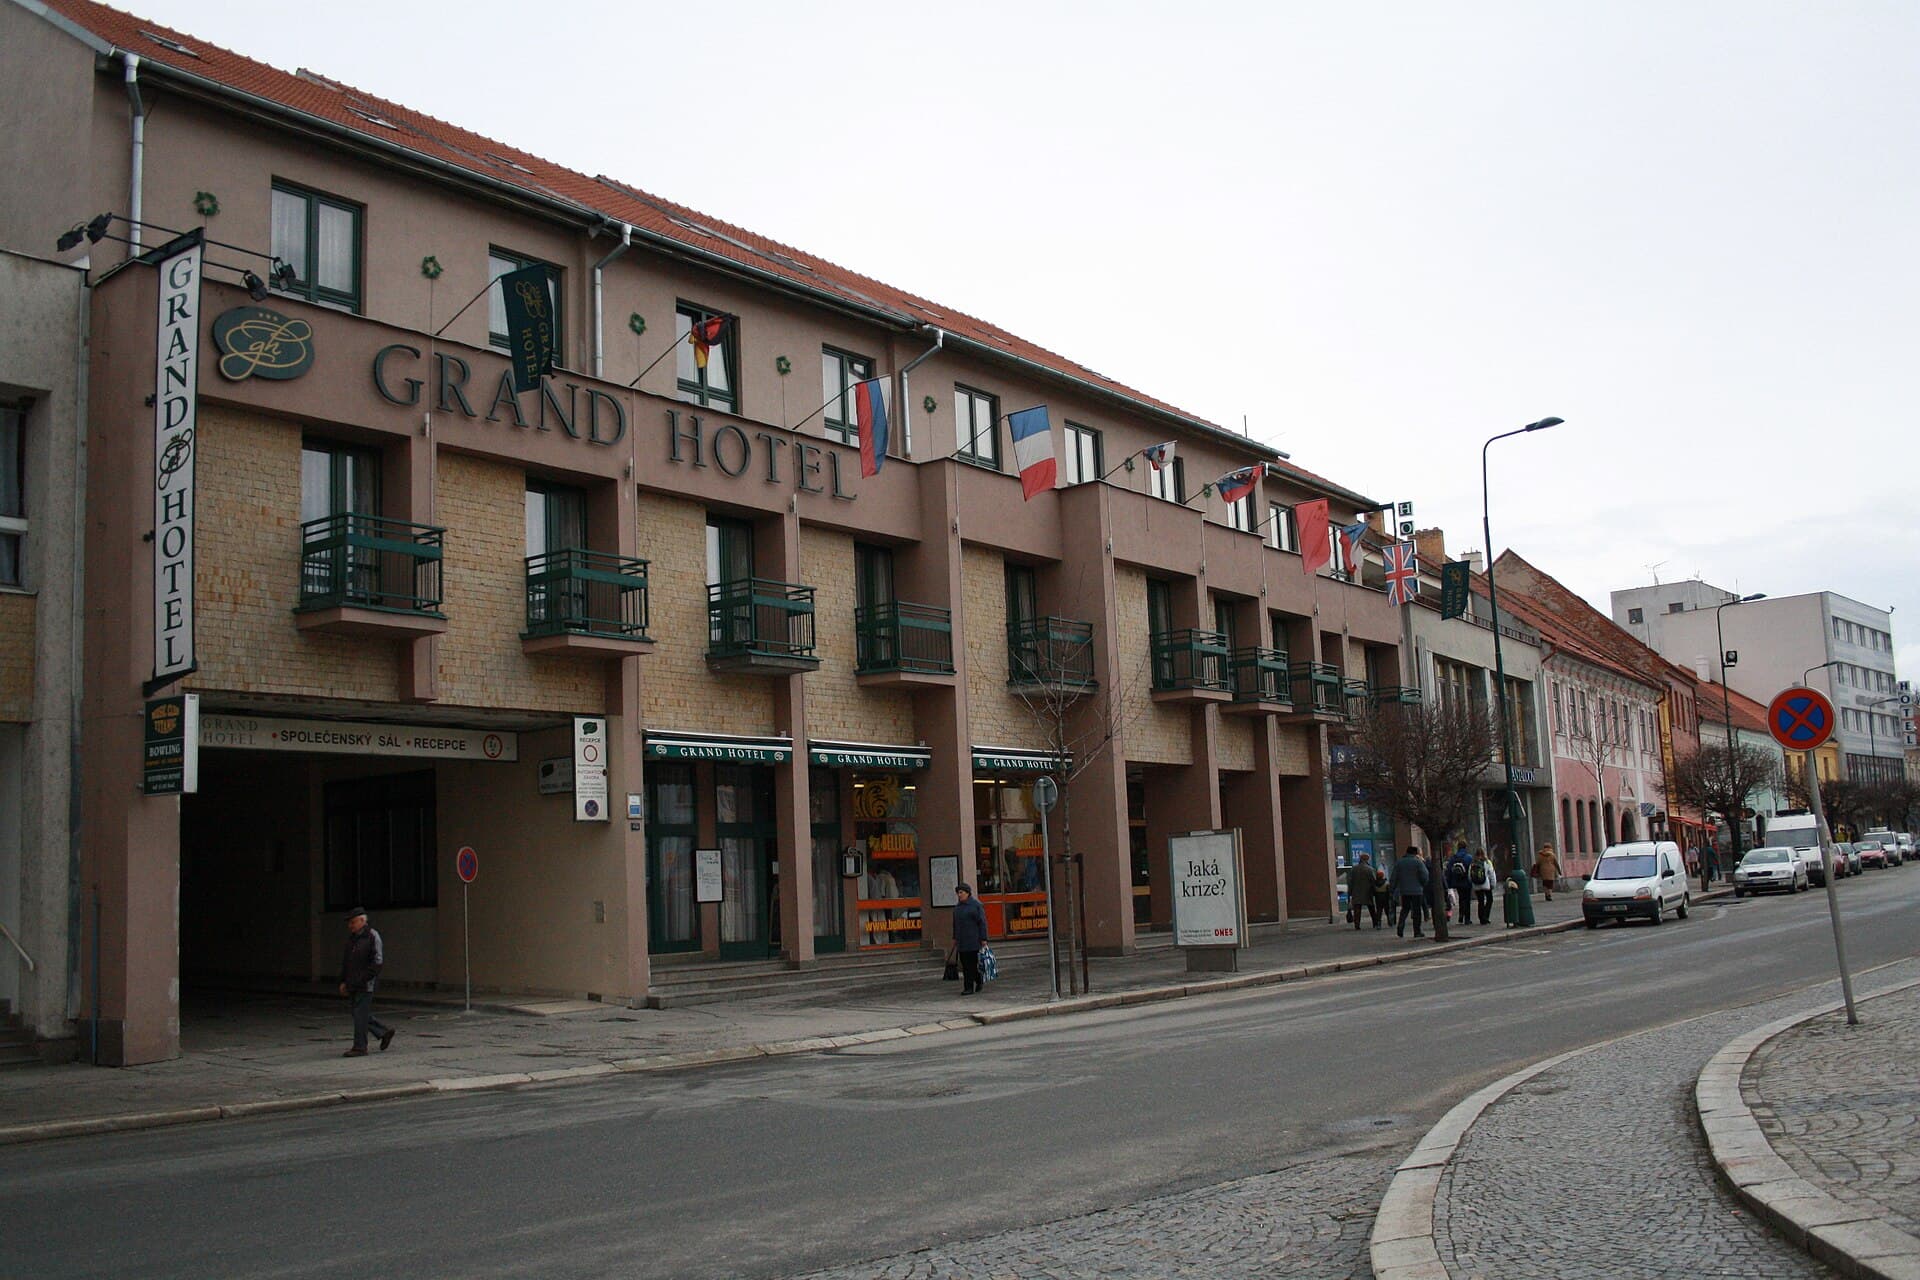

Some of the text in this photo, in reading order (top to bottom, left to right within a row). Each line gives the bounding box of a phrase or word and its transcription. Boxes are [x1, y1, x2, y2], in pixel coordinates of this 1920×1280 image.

[162, 256, 192, 433] GRAND
[374, 343, 858, 500] GRAND HOTEL
[162, 487, 188, 668] HOTEL
[1900, 682, 1912, 744] HOTEL
[202, 718, 258, 732] GRAND
[202, 731, 257, 745] HOTEL
[280, 729, 467, 751] SPOLEČENSKÝ SÁL RECEPCE
[149, 743, 181, 757] BOWLING
[680, 746, 766, 761] GRAND HOTEL
[837, 753, 909, 767] GRAND HOTEL
[993, 758, 1054, 770] GRAND HOTEL
[1186, 858, 1219, 878] Jaká
[1181, 878, 1226, 898] krize?
